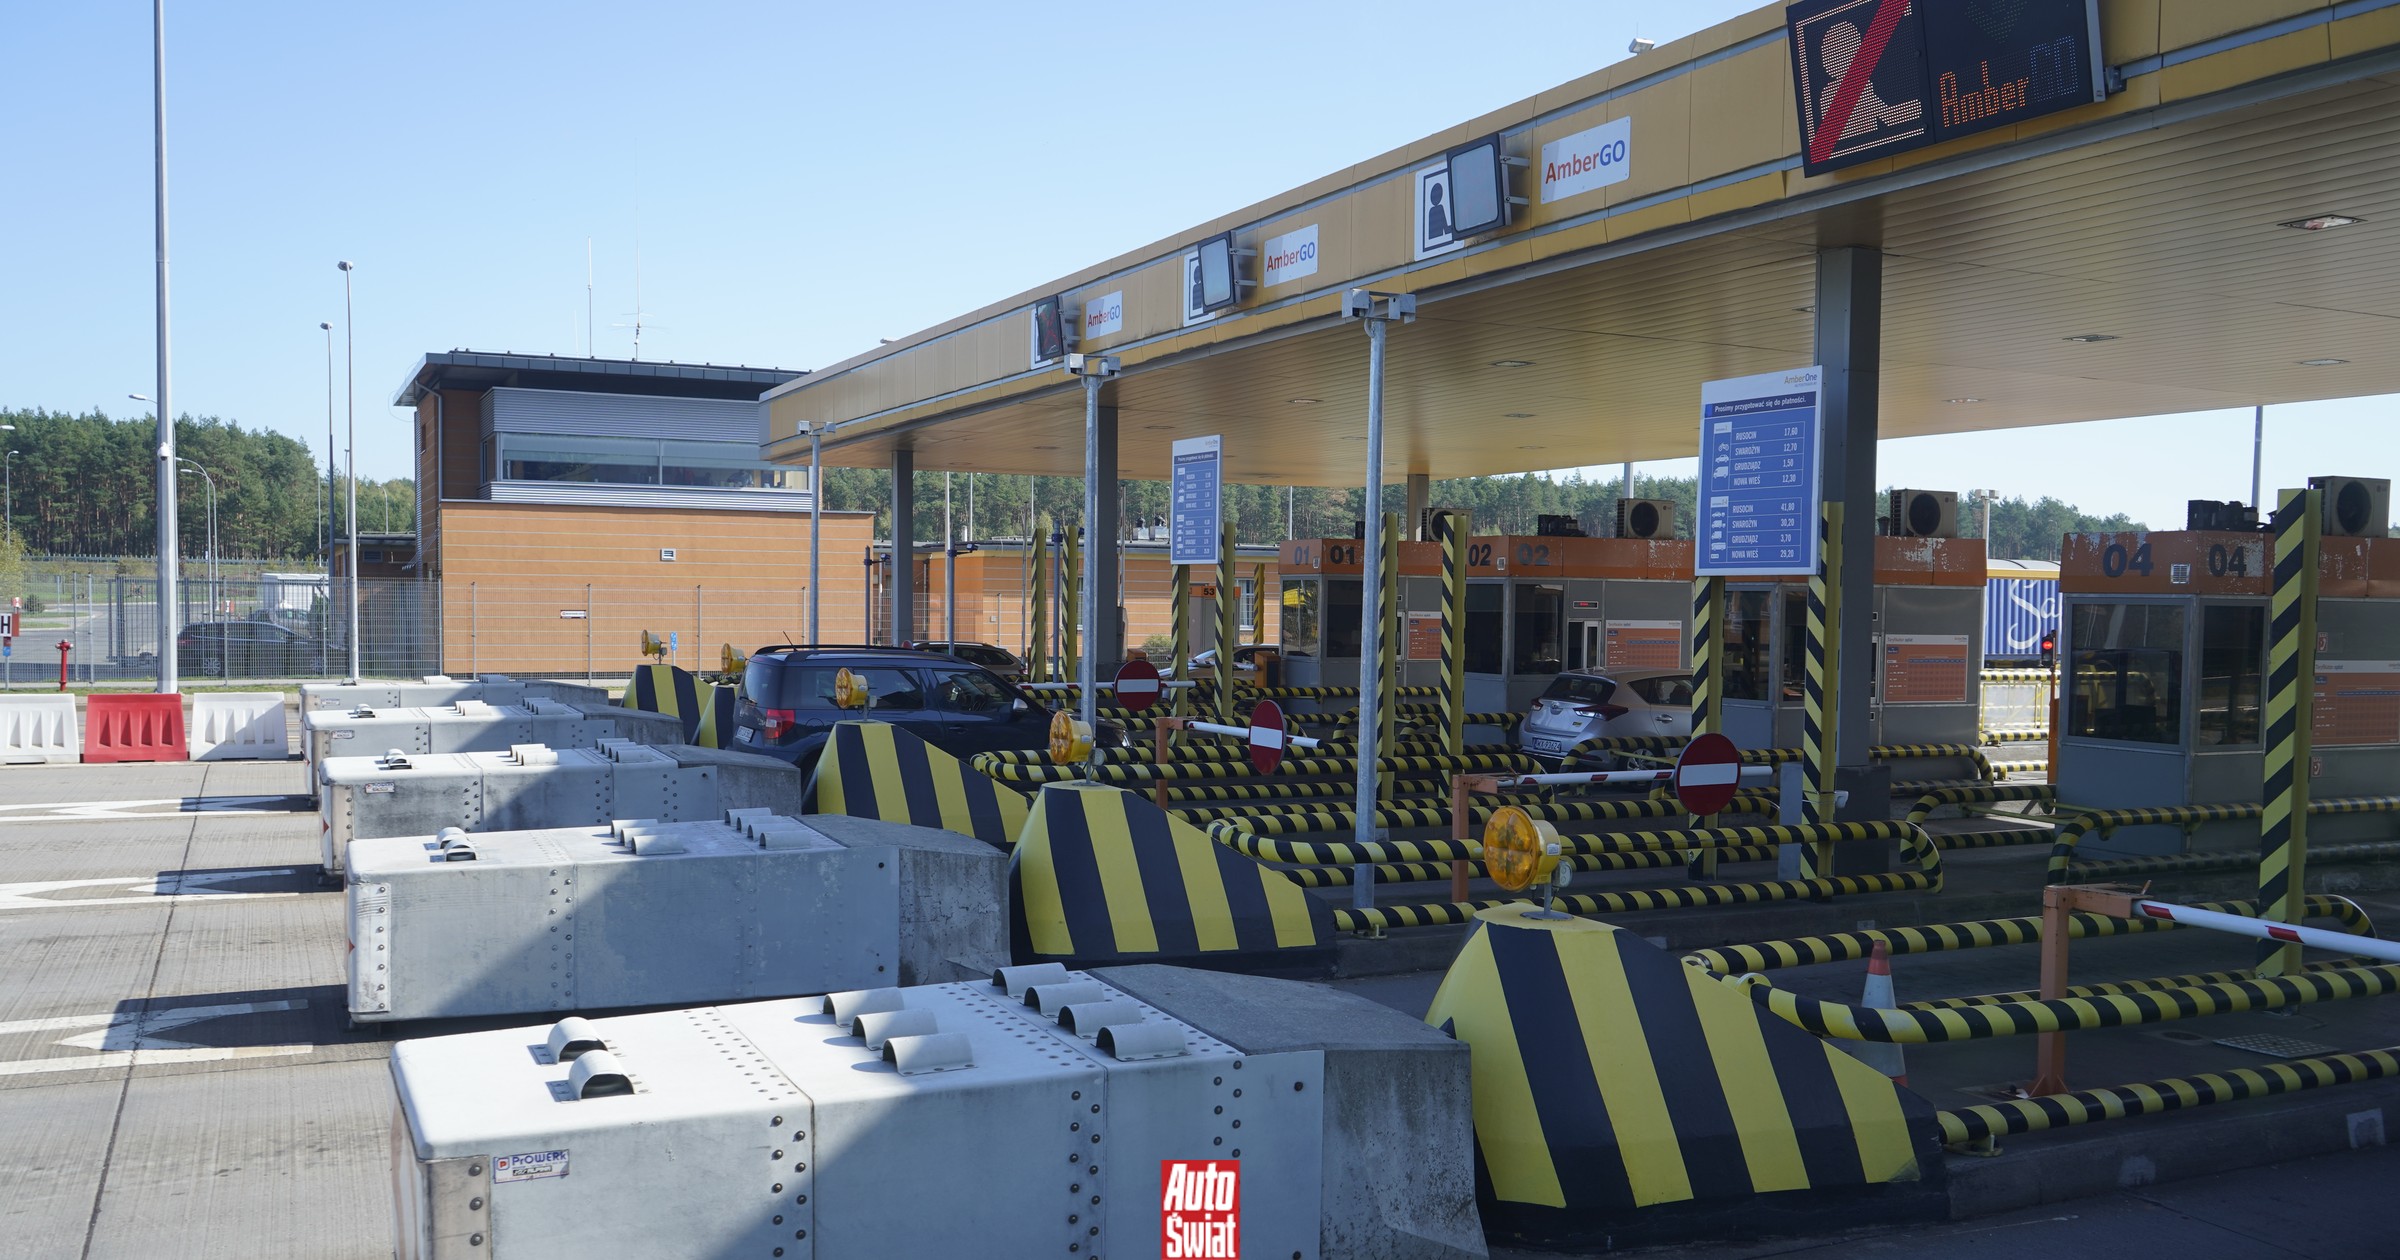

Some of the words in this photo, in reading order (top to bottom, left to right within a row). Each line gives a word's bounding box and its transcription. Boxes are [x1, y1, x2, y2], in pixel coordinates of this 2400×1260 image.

[1545, 140, 1626, 184] AmberGO
[1266, 241, 1316, 273] AmberGO
[1087, 304, 1121, 328] AmberGO
[1714, 405, 1733, 413] Prosimy
[1734, 401, 1765, 411] przygotować
[1765, 400, 1773, 408] się
[1736, 431, 1757, 440] RUSOCIN
[1735, 444, 1760, 455] SWAROŻYN
[1783, 443, 1797, 452] 12,70
[1734, 461, 1761, 471] GRUDZIĄDZ
[1734, 477, 1747, 486] NOWA
[1748, 475, 1760, 485] WIEŚ
[1732, 505, 1753, 513] RUSOCIN
[1732, 518, 1757, 528] SWAROŻYN
[1780, 518, 1794, 527] 30,20
[1731, 535, 1758, 544] GRUDZIĄDZ
[1780, 534, 1791, 542] 3,70
[1294, 545, 1309, 565] 01
[1330, 544, 1355, 565] 01
[1468, 543, 1491, 566] 02
[1518, 543, 1551, 566] 02
[1732, 550, 1746, 558] NOWA
[1746, 548, 1759, 558] WIEŚ
[1780, 549, 1794, 558] 29,20
[2103, 543, 2154, 578] 04
[2208, 544, 2247, 578] 04
[1203, 588, 1215, 596] 53
